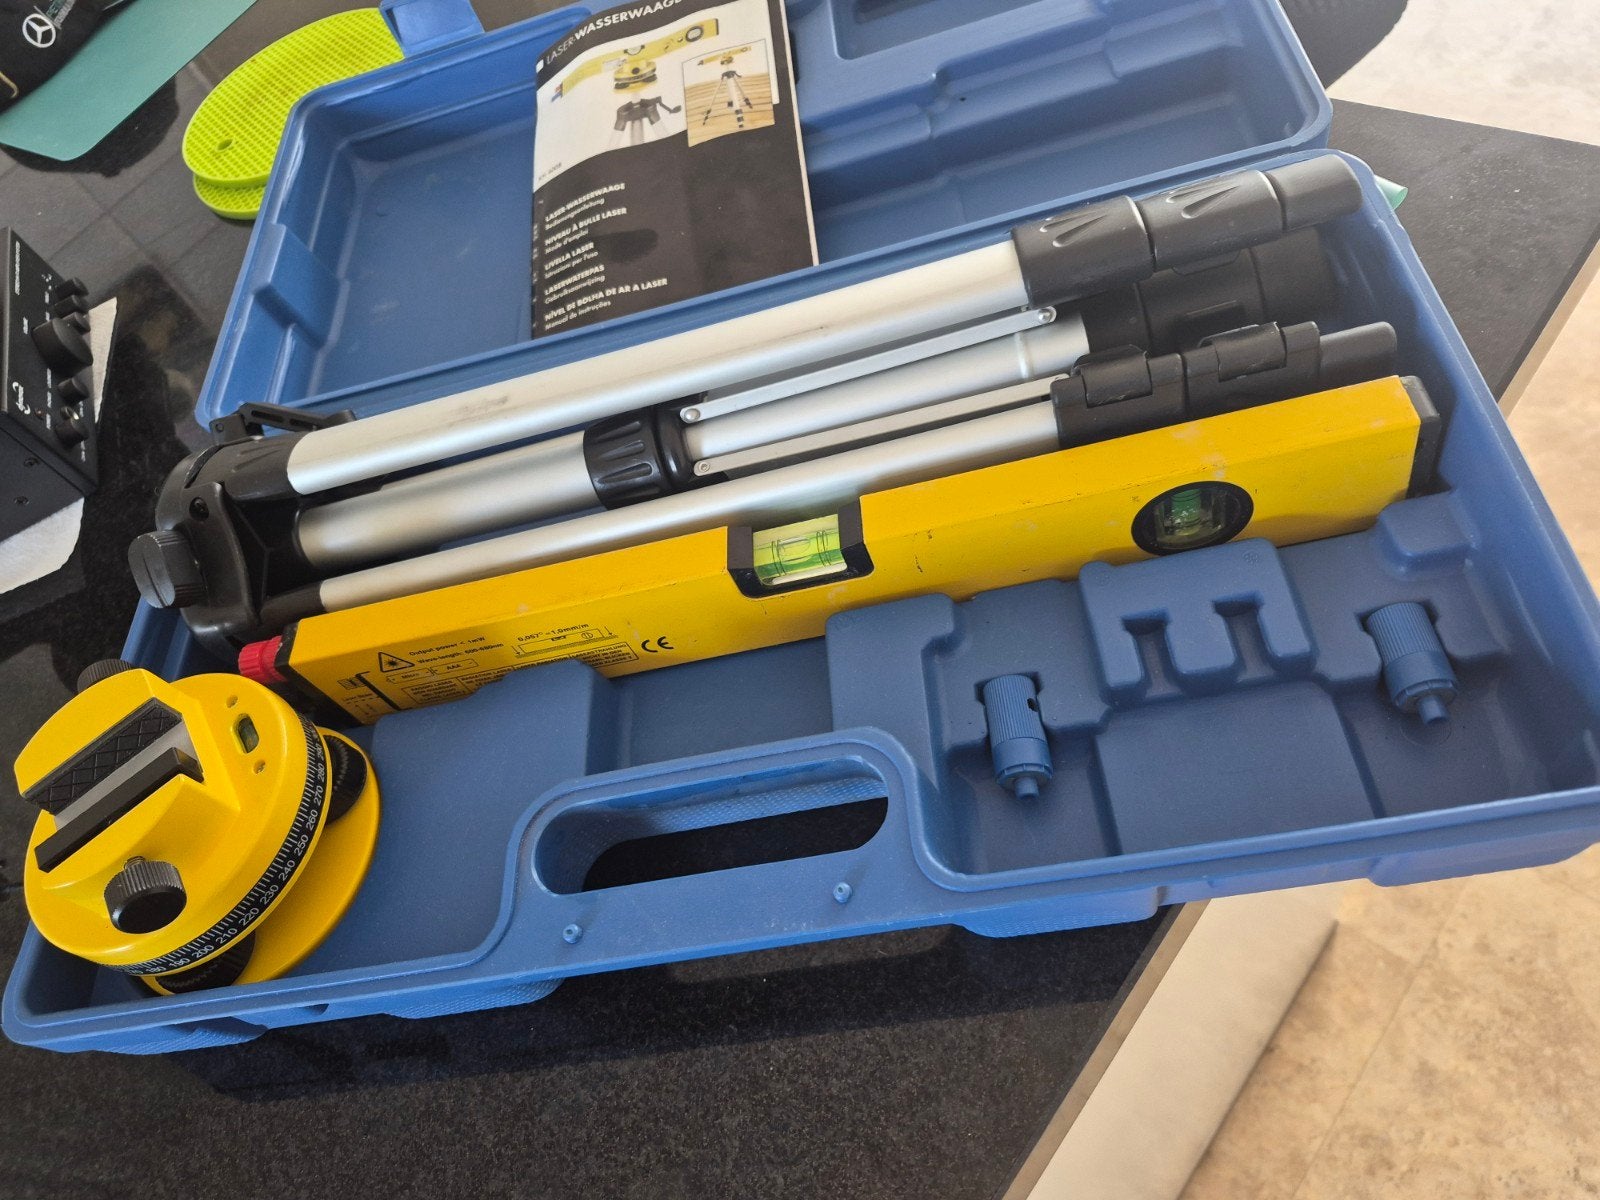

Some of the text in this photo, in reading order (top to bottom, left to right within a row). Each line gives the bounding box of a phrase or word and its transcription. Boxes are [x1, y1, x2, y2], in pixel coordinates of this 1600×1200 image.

[545, 183, 625, 222] LASER-WASSERWAAGE
[544, 228, 571, 245] NIVEAU
[578, 214, 601, 229] BULLE
[601, 207, 627, 219] LASER
[544, 252, 571, 271] LIVELLA
[571, 241, 594, 257] LASER
[572, 257, 583, 268] per
[544, 264, 605, 295] LASERWATERPAS
[566, 302, 576, 311] DE
[577, 292, 604, 307] BOLHA
[605, 288, 616, 297] DE
[618, 285, 630, 294] AR
[632, 284, 640, 292] A
[641, 278, 668, 290] LASER
[545, 316, 568, 331] Manual
[578, 301, 611, 316] instruções
[409, 648, 434, 656] Output
[435, 642, 457, 651] power
[641, 636, 674, 653] CE
[313, 785, 324, 806] 270
[306, 809, 319, 831] 260
[294, 834, 309, 856] 250
[278, 860, 296, 882] 240
[260, 884, 279, 905] 230
[239, 907, 260, 927] 220
[215, 928, 238, 945] 210
[169, 957, 190, 968] 190
[192, 944, 215, 960] 200
